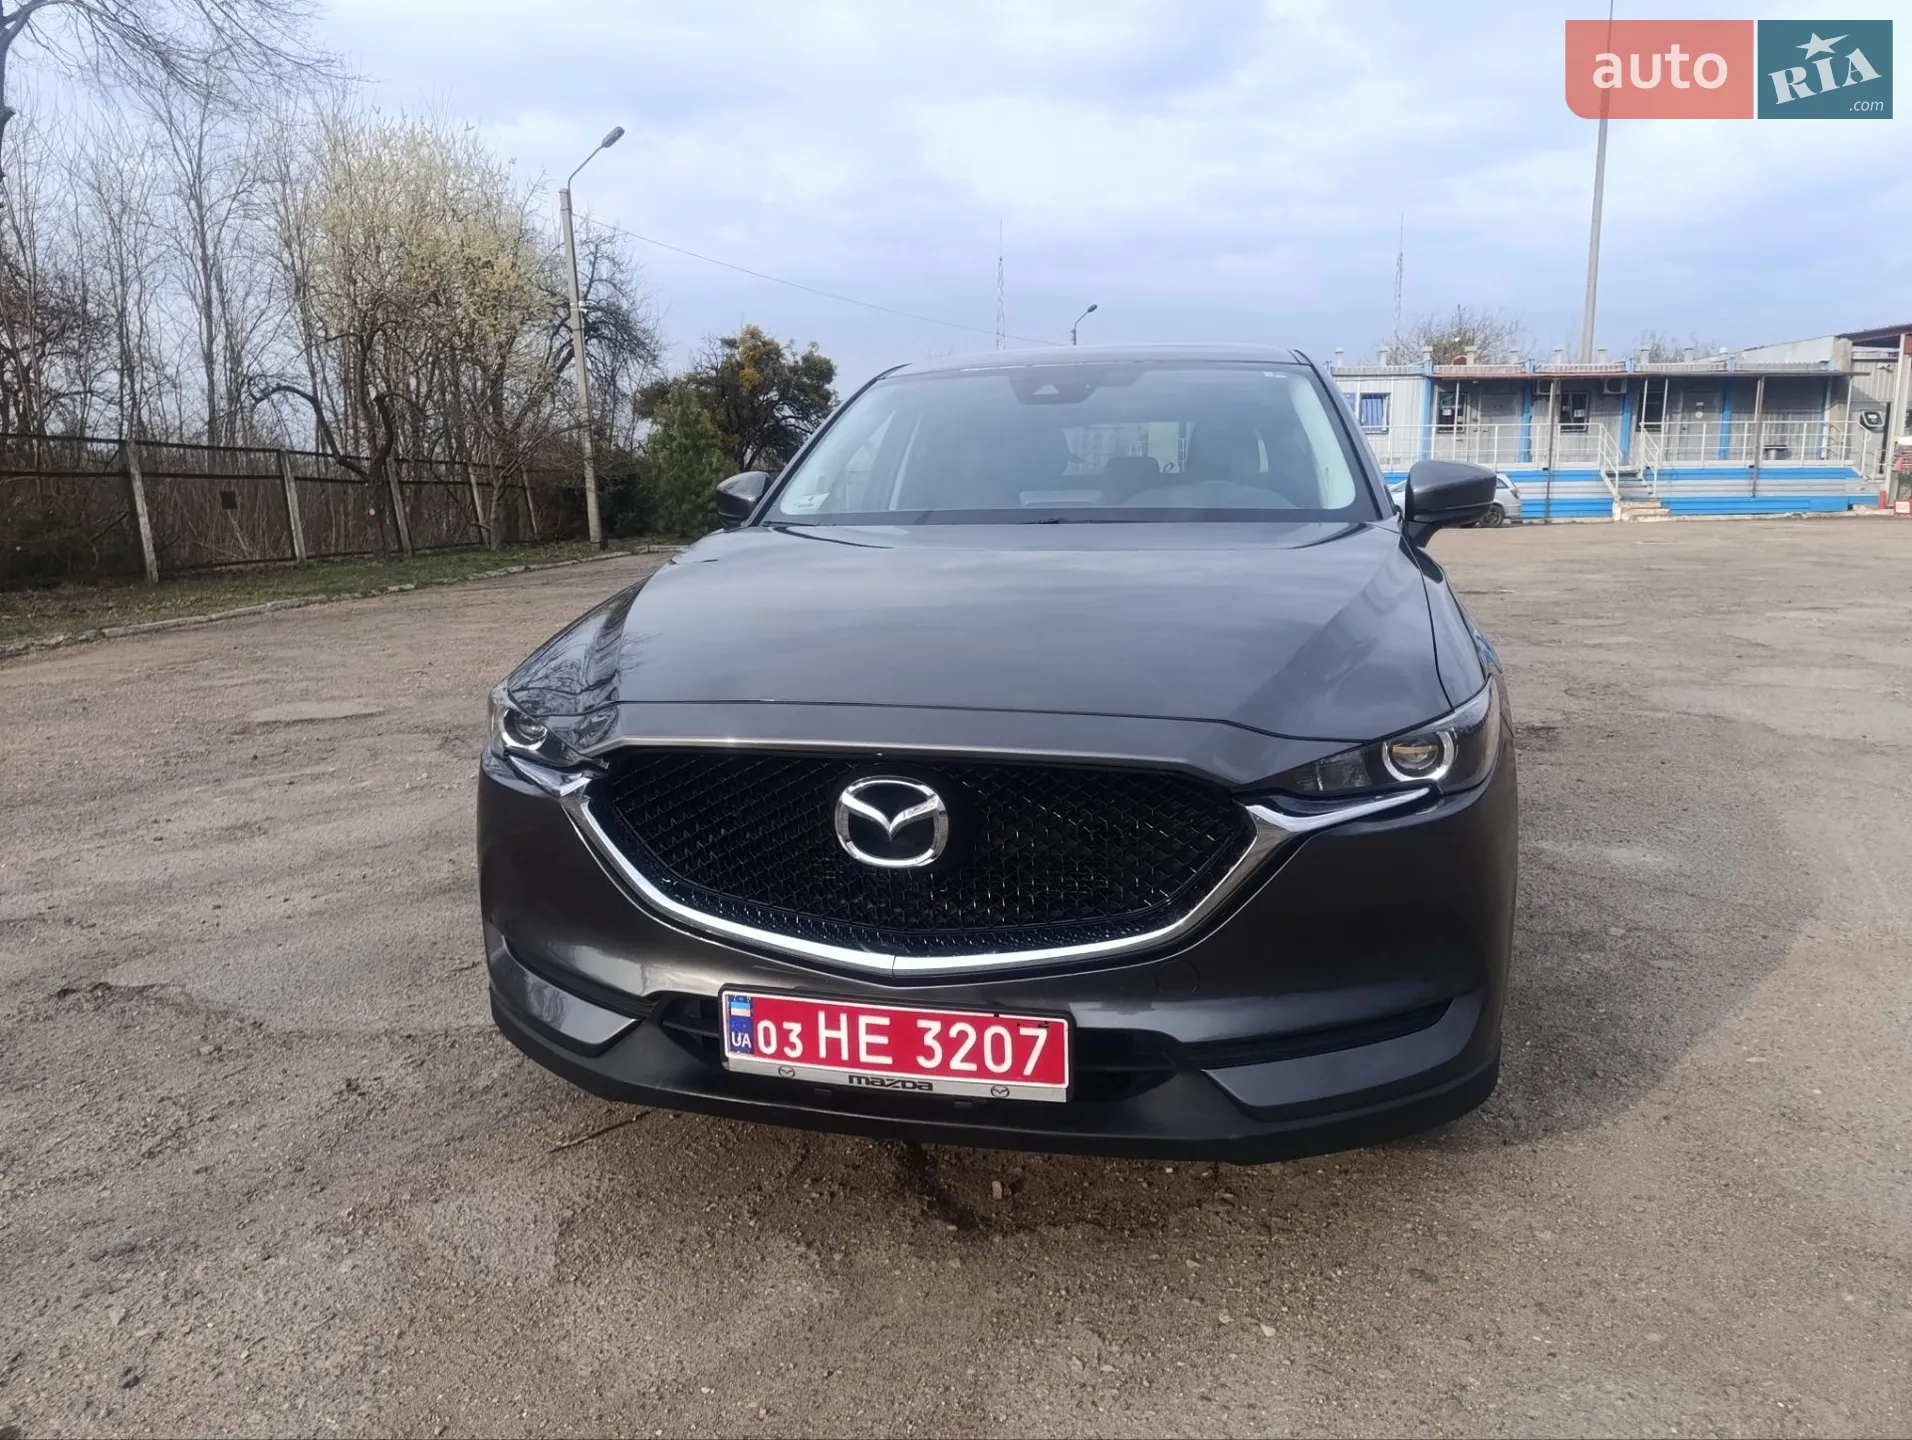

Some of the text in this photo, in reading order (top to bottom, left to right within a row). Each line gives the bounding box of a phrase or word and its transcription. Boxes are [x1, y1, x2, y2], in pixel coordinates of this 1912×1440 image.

[731, 1032, 753, 1049] UA
[757, 1010, 1048, 1076] 03 HE 3207
[848, 1074, 934, 1092] mazda
